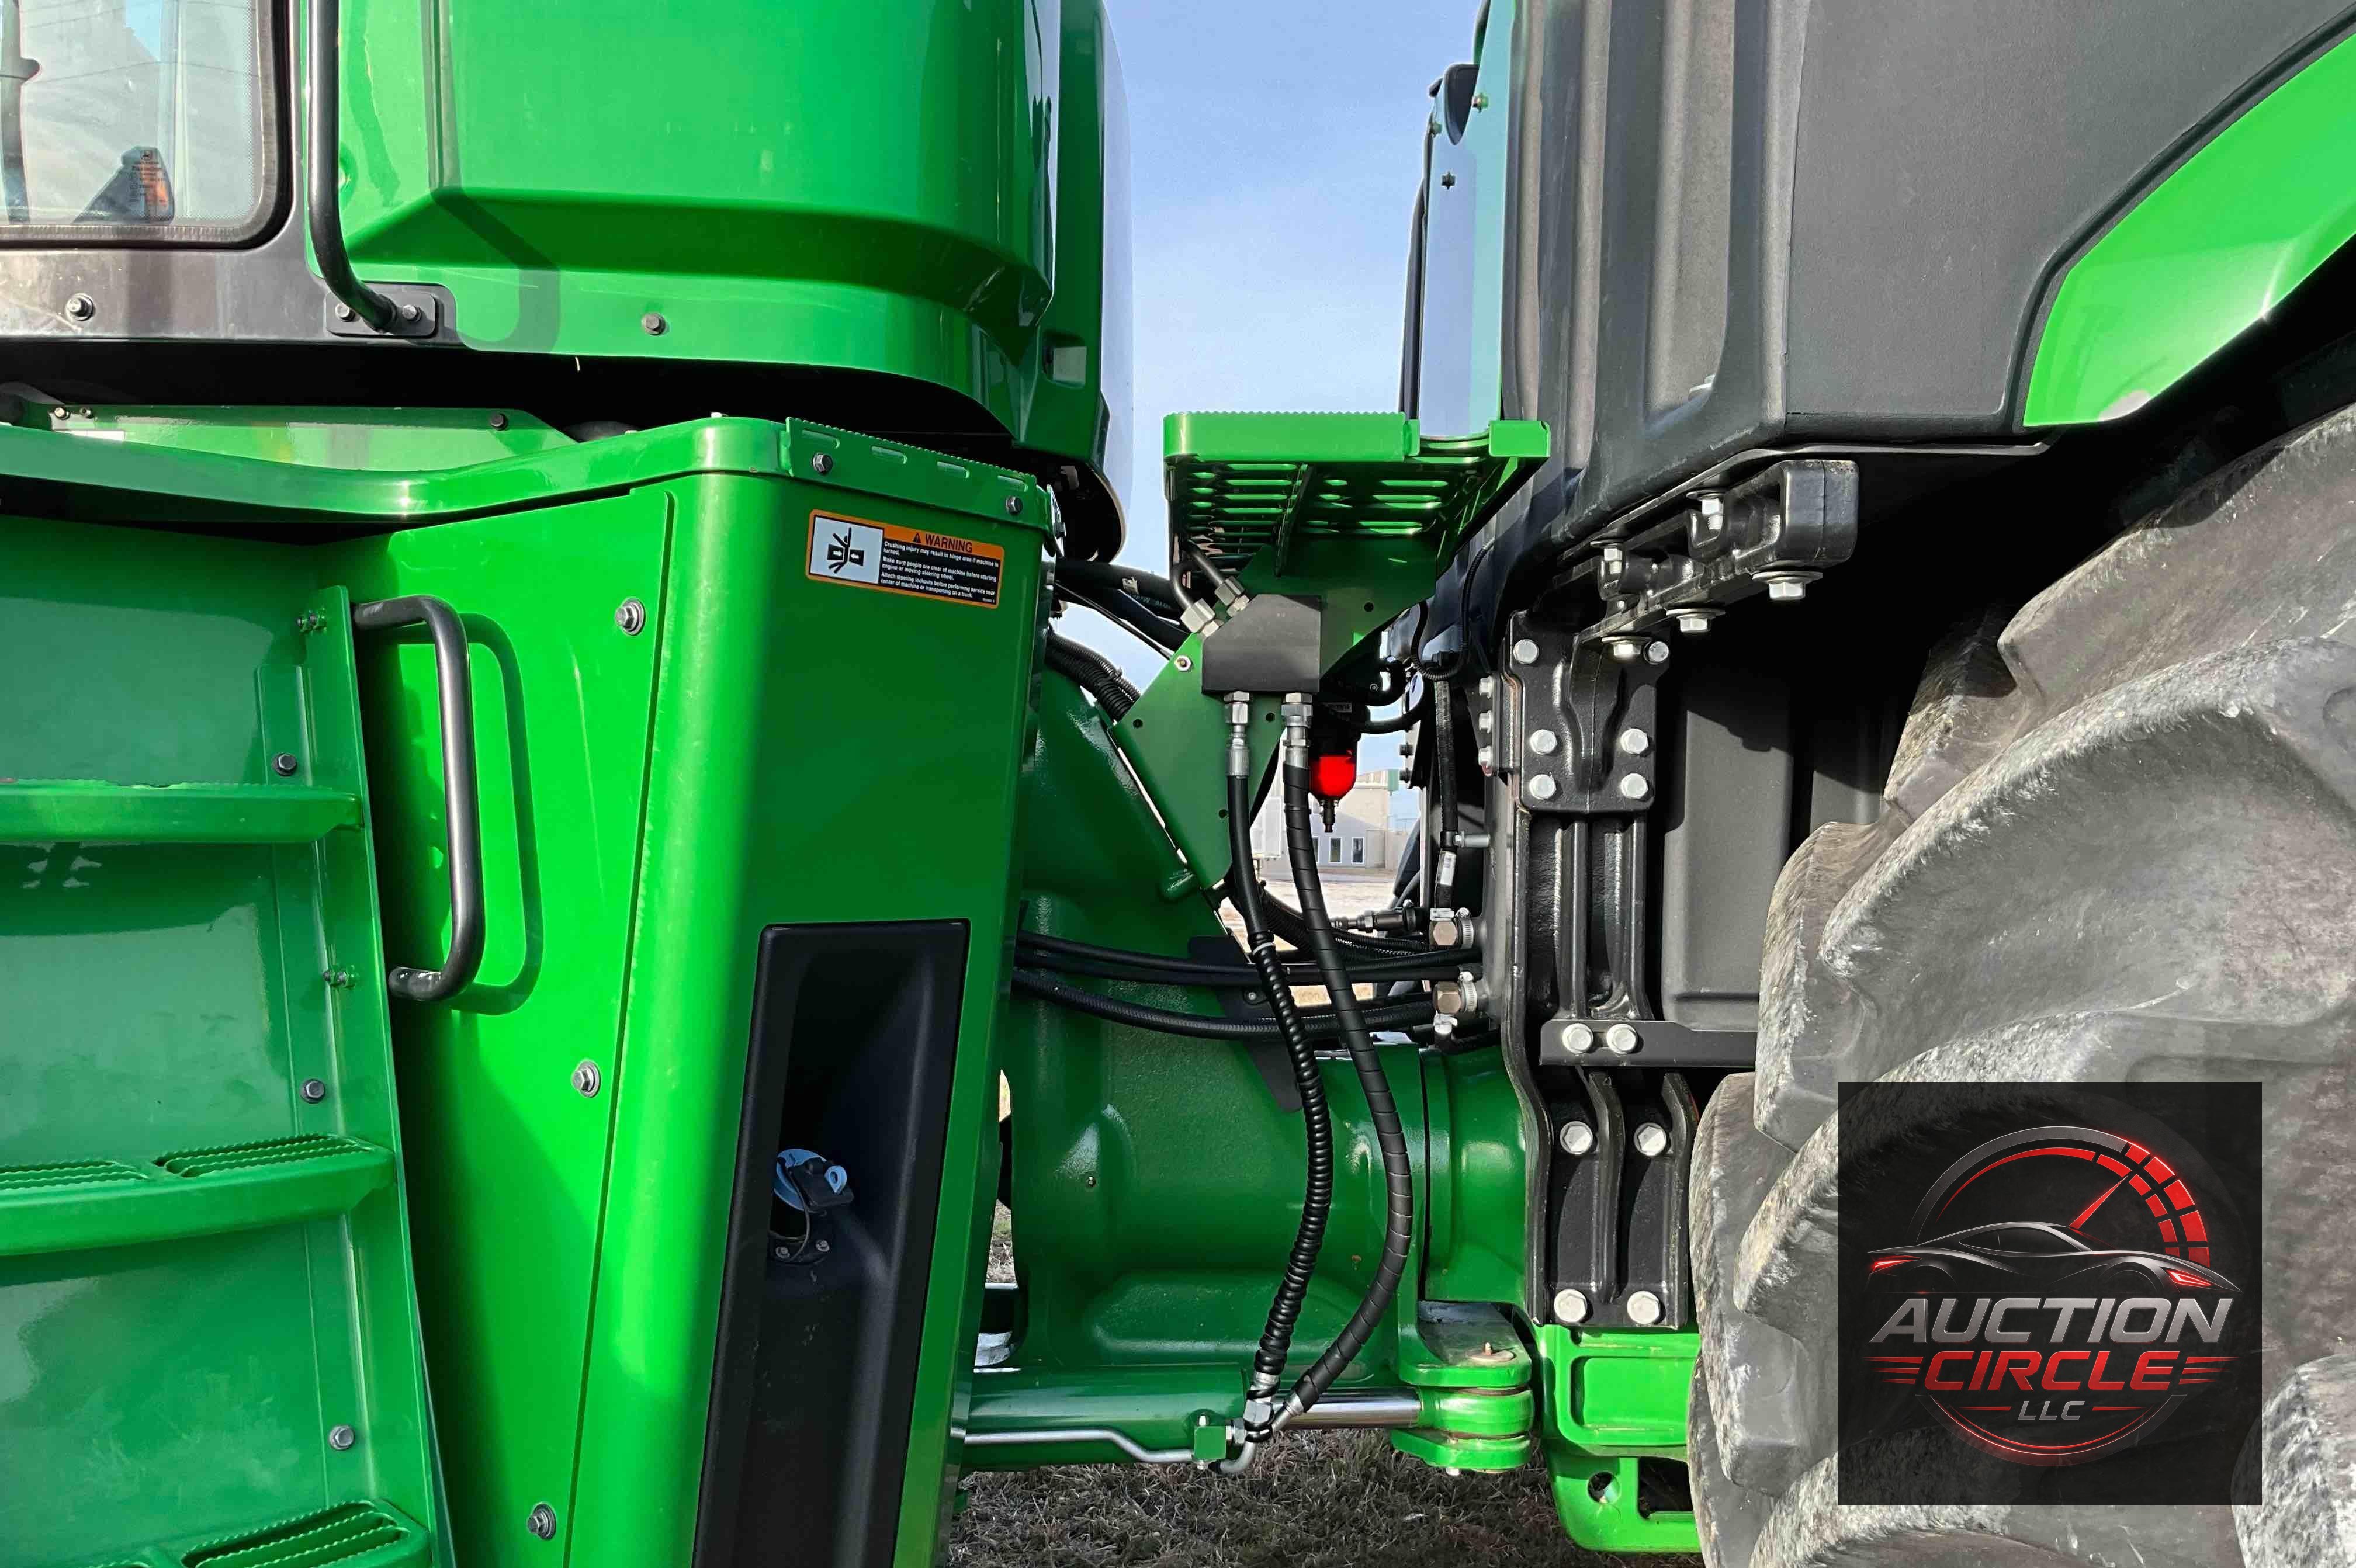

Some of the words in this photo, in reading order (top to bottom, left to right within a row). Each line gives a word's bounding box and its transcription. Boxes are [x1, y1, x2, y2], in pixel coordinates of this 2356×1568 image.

[884, 541, 905, 551] Crushing
[906, 546, 920, 554] injury
[925, 533, 972, 553] WARNING
[904, 567, 921, 575] moving
[922, 570, 940, 579] steering
[980, 574, 996, 582] starting
[896, 575, 914, 583] steering
[915, 577, 933, 585] lockouts
[948, 584, 970, 592] performing
[925, 585, 951, 595] transporting
